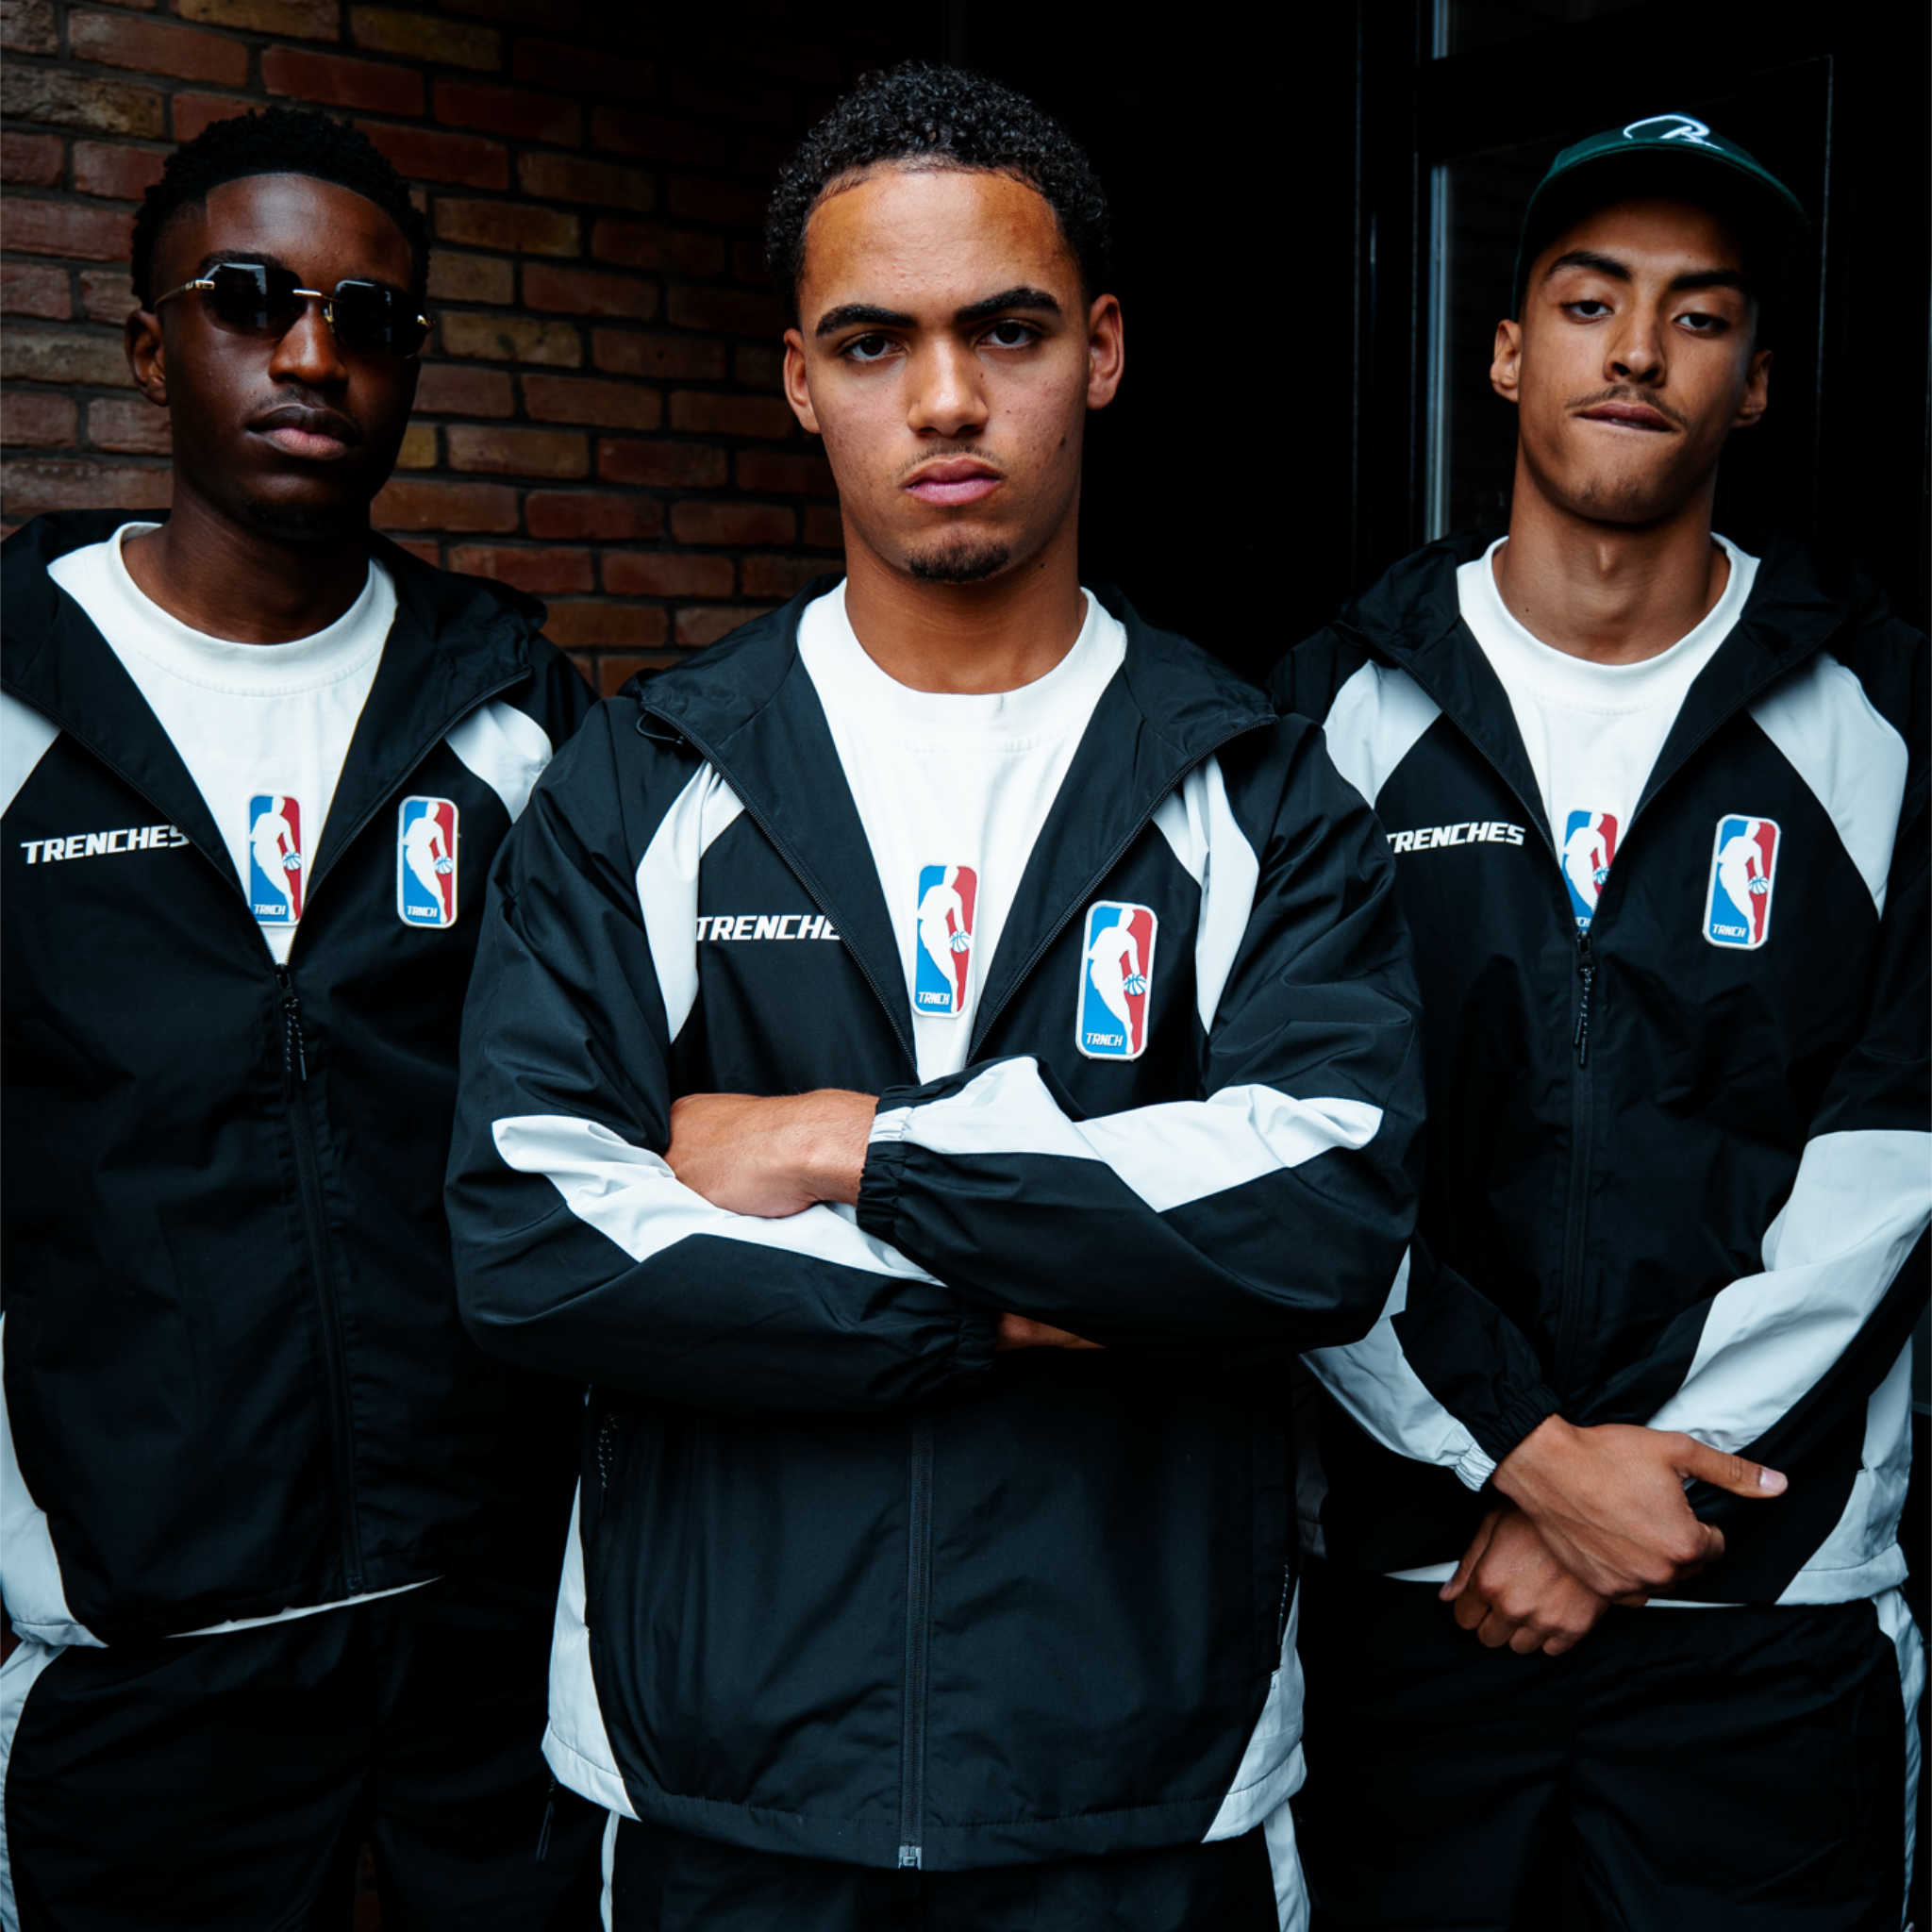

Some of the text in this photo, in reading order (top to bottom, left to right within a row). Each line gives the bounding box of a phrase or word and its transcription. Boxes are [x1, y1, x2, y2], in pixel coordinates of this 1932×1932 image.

[21, 824, 190, 864] TRENCHES
[254, 904, 287, 916] TRNCH
[407, 906, 439, 918] TRNCH
[1712, 924, 1747, 938] TRNCH
[918, 991, 951, 1006] TRNCH
[1086, 1032, 1124, 1047] TRNCH
